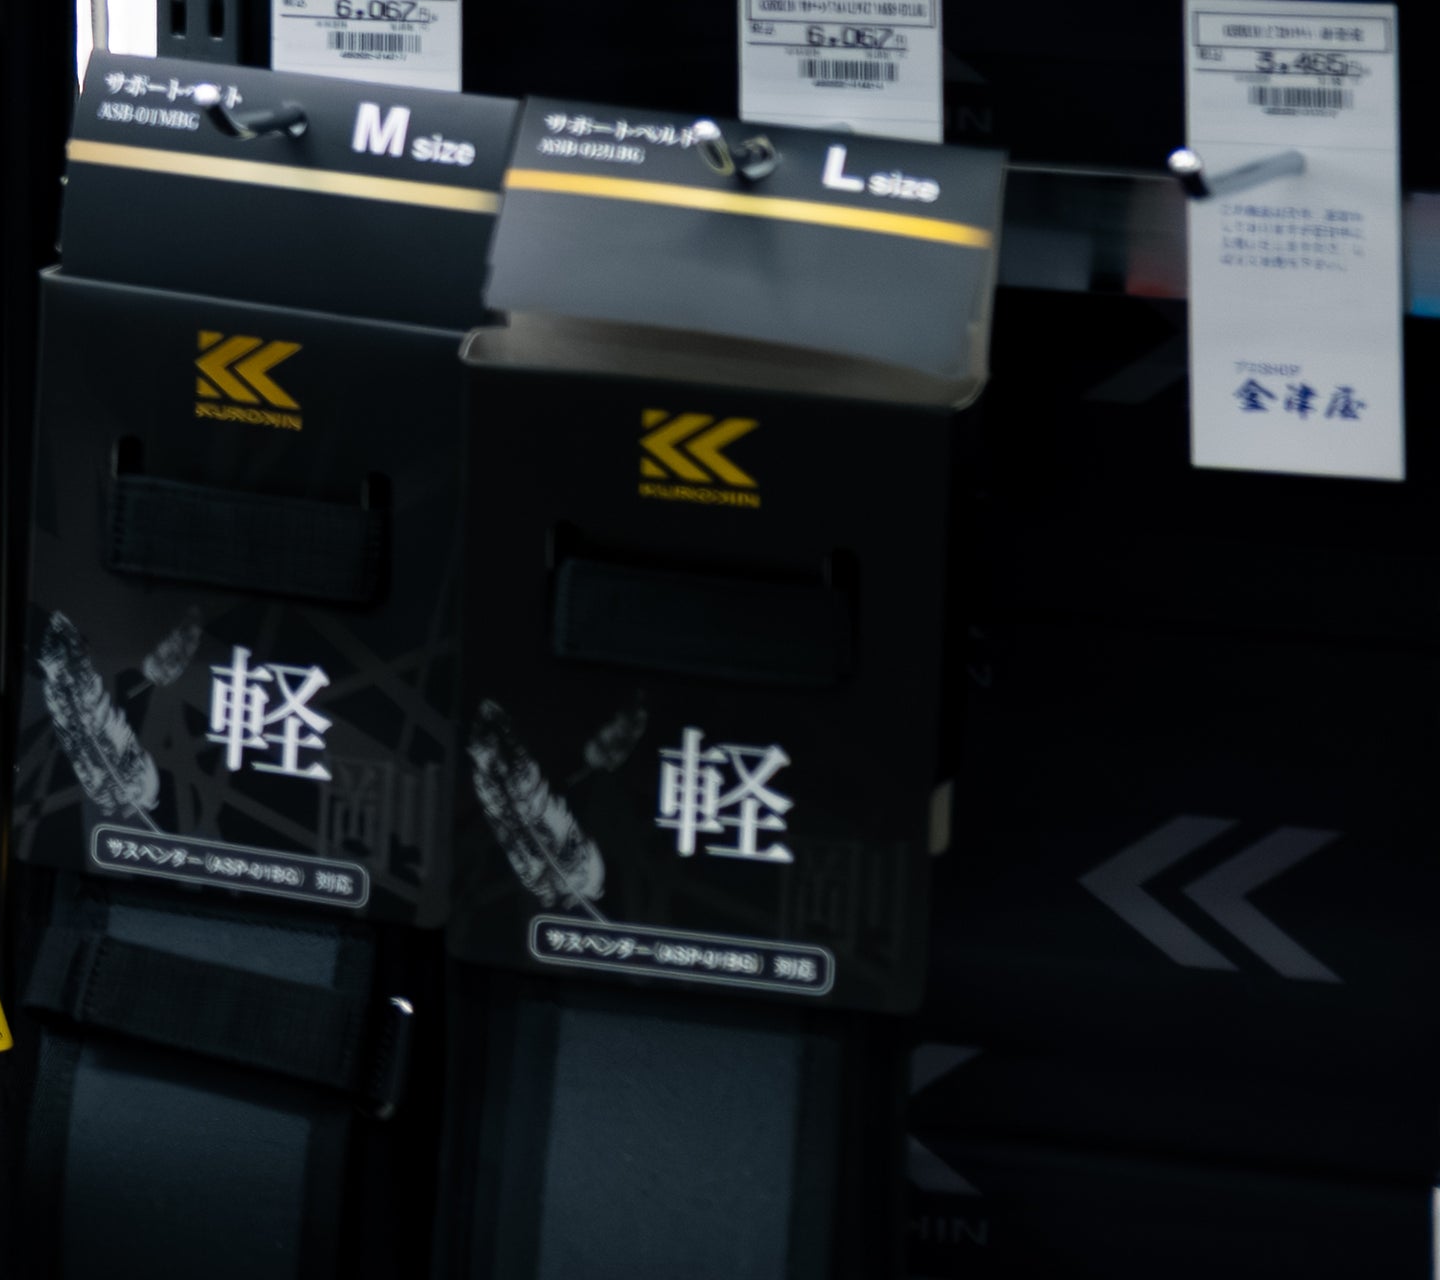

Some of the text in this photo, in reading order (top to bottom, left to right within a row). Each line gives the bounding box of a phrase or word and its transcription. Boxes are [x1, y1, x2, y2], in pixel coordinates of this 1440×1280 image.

[353, 104, 476, 166] M size
[822, 145, 941, 203] L size
[205, 646, 335, 782] 軽
[655, 726, 795, 864] 軽
